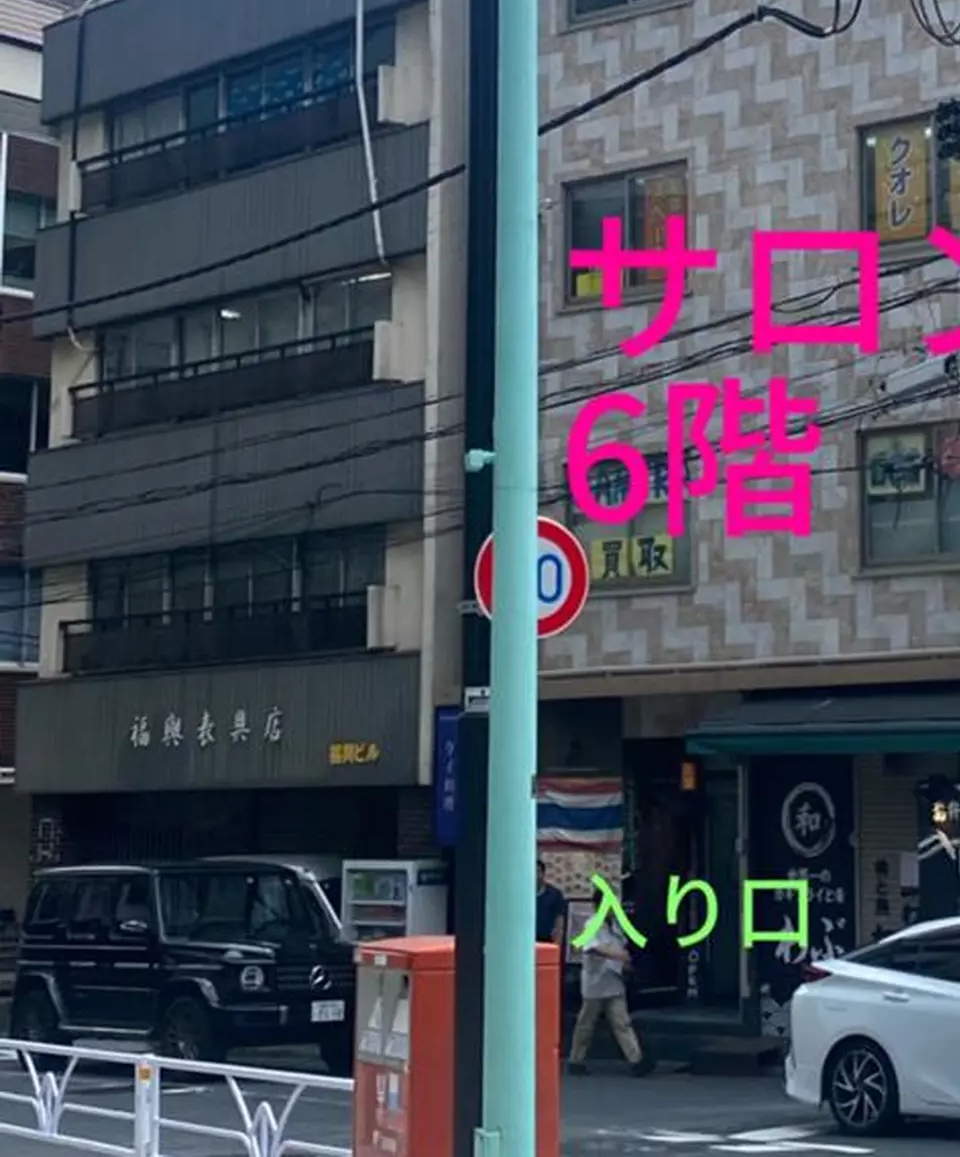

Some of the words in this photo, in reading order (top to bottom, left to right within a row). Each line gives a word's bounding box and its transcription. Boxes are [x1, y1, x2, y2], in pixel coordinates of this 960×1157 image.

[890, 137, 912, 227] クオレ
[601, 537, 669, 580] 買取
